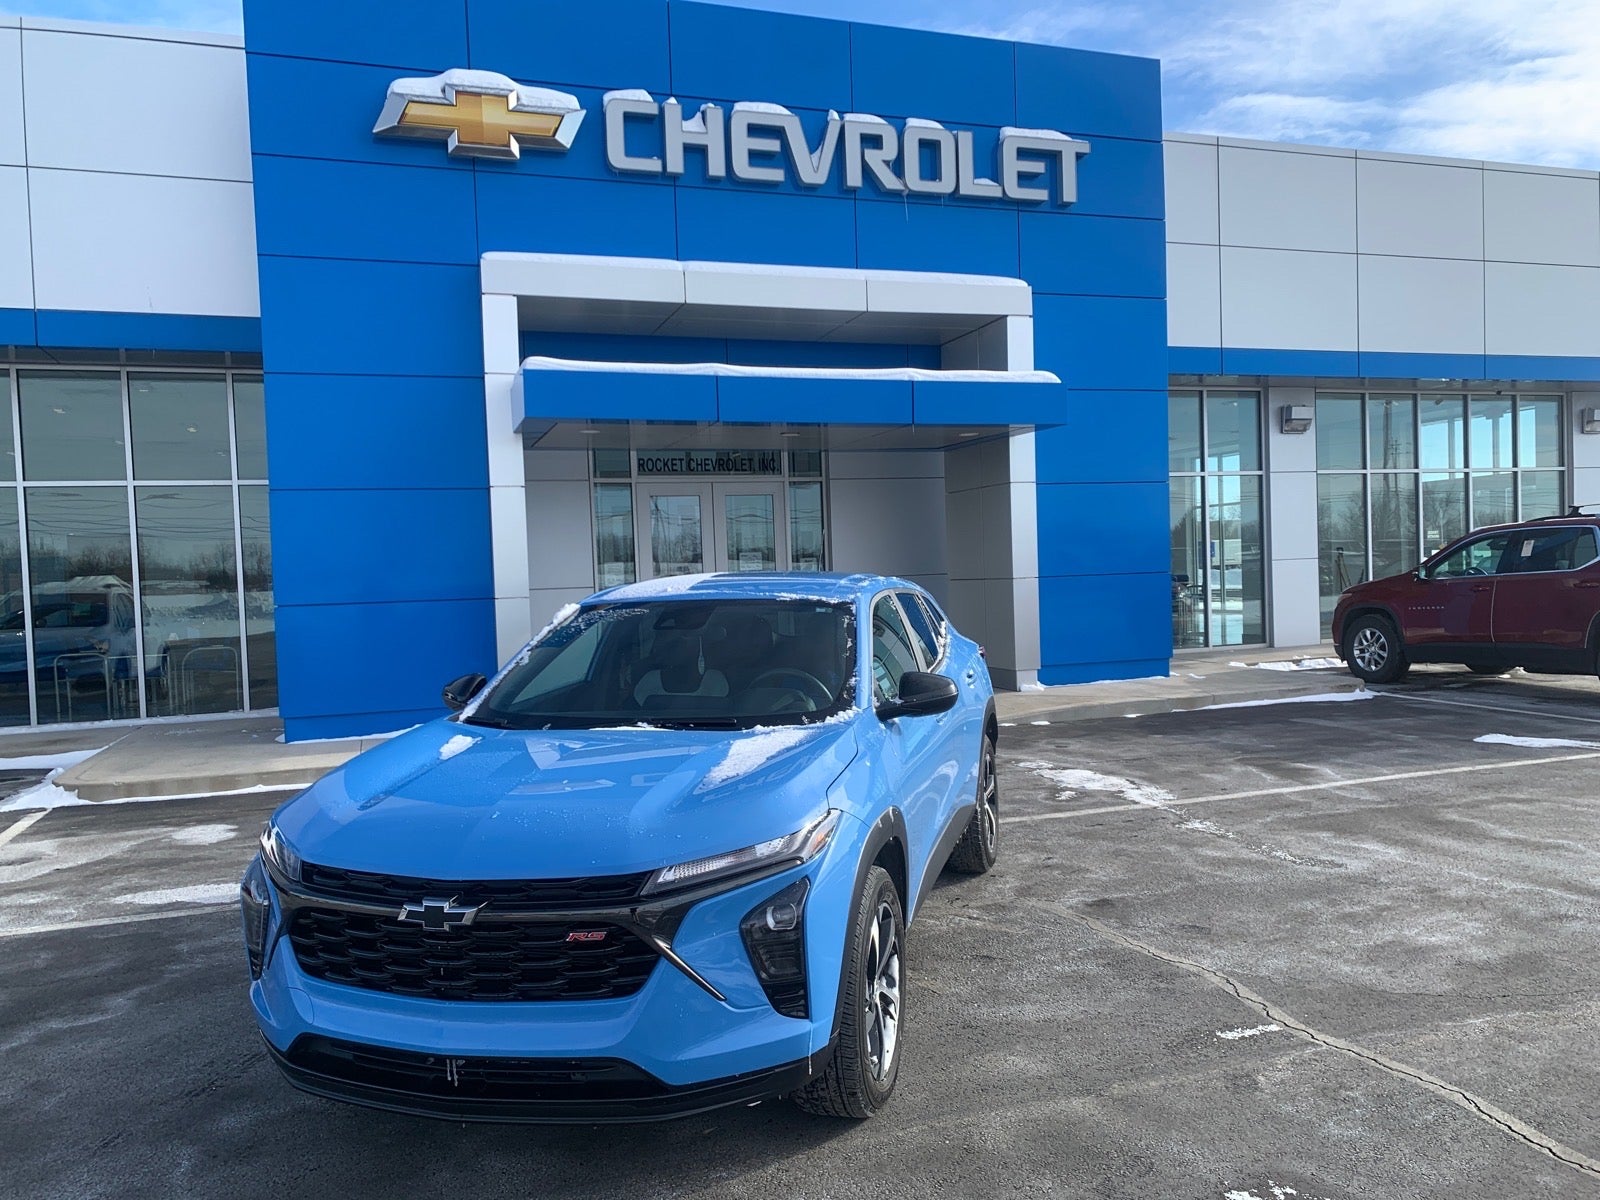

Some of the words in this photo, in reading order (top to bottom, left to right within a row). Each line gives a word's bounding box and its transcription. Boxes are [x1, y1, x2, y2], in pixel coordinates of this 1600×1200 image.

[605, 96, 1090, 205] CHEVROLET
[638, 457, 685, 473] ROCKET
[566, 931, 607, 941] RS
